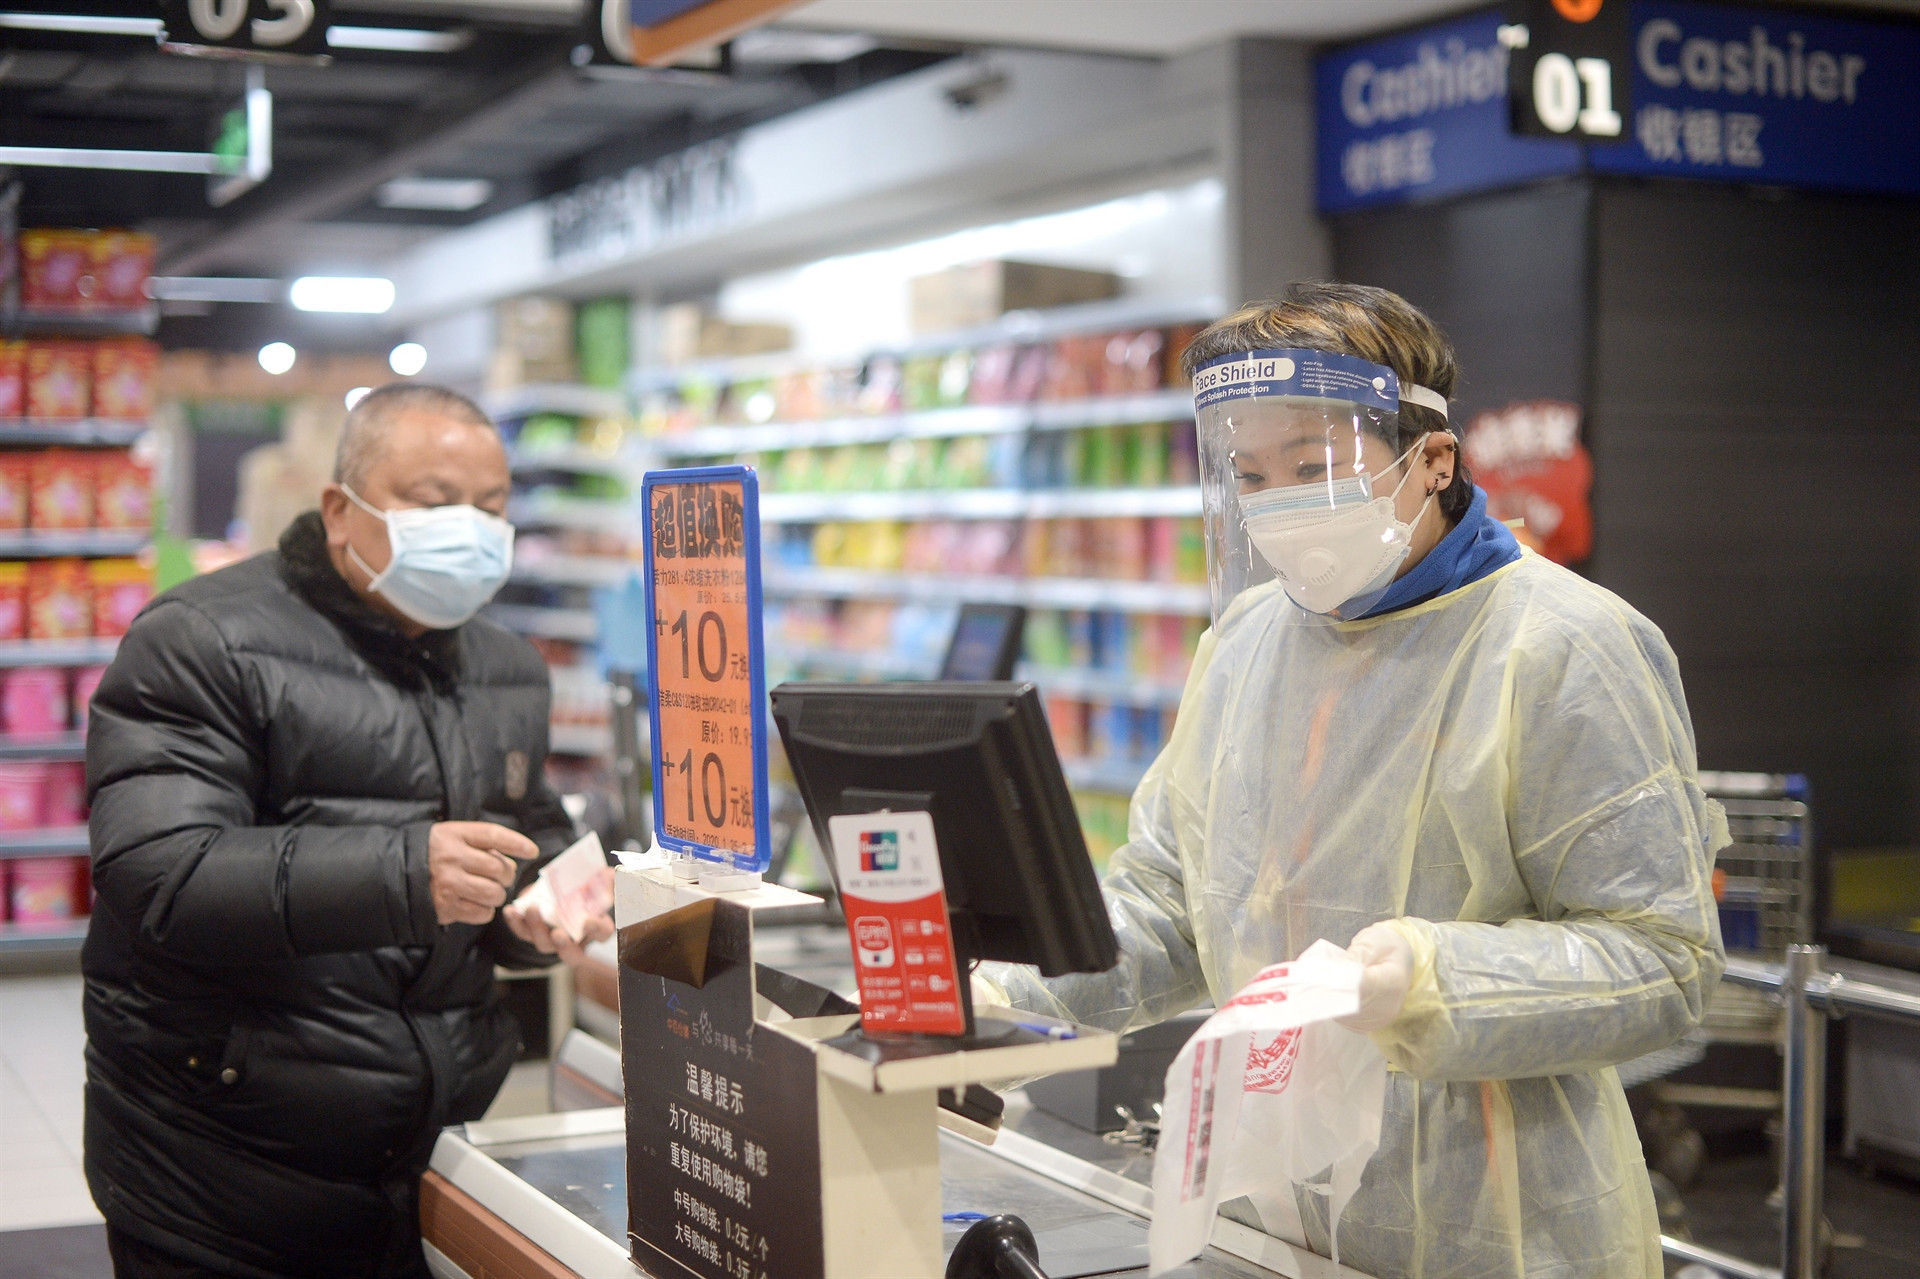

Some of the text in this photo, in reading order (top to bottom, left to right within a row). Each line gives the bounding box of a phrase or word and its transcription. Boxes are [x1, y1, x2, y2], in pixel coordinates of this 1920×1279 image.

[1636, 17, 1867, 103] Cashier
[1532, 51, 1623, 137] 01
[1196, 361, 1275, 392] Face Shield
[1208, 390, 1227, 402] Splash
[1228, 385, 1269, 396] Protection
[686, 1061, 744, 1115] 温馨提示
